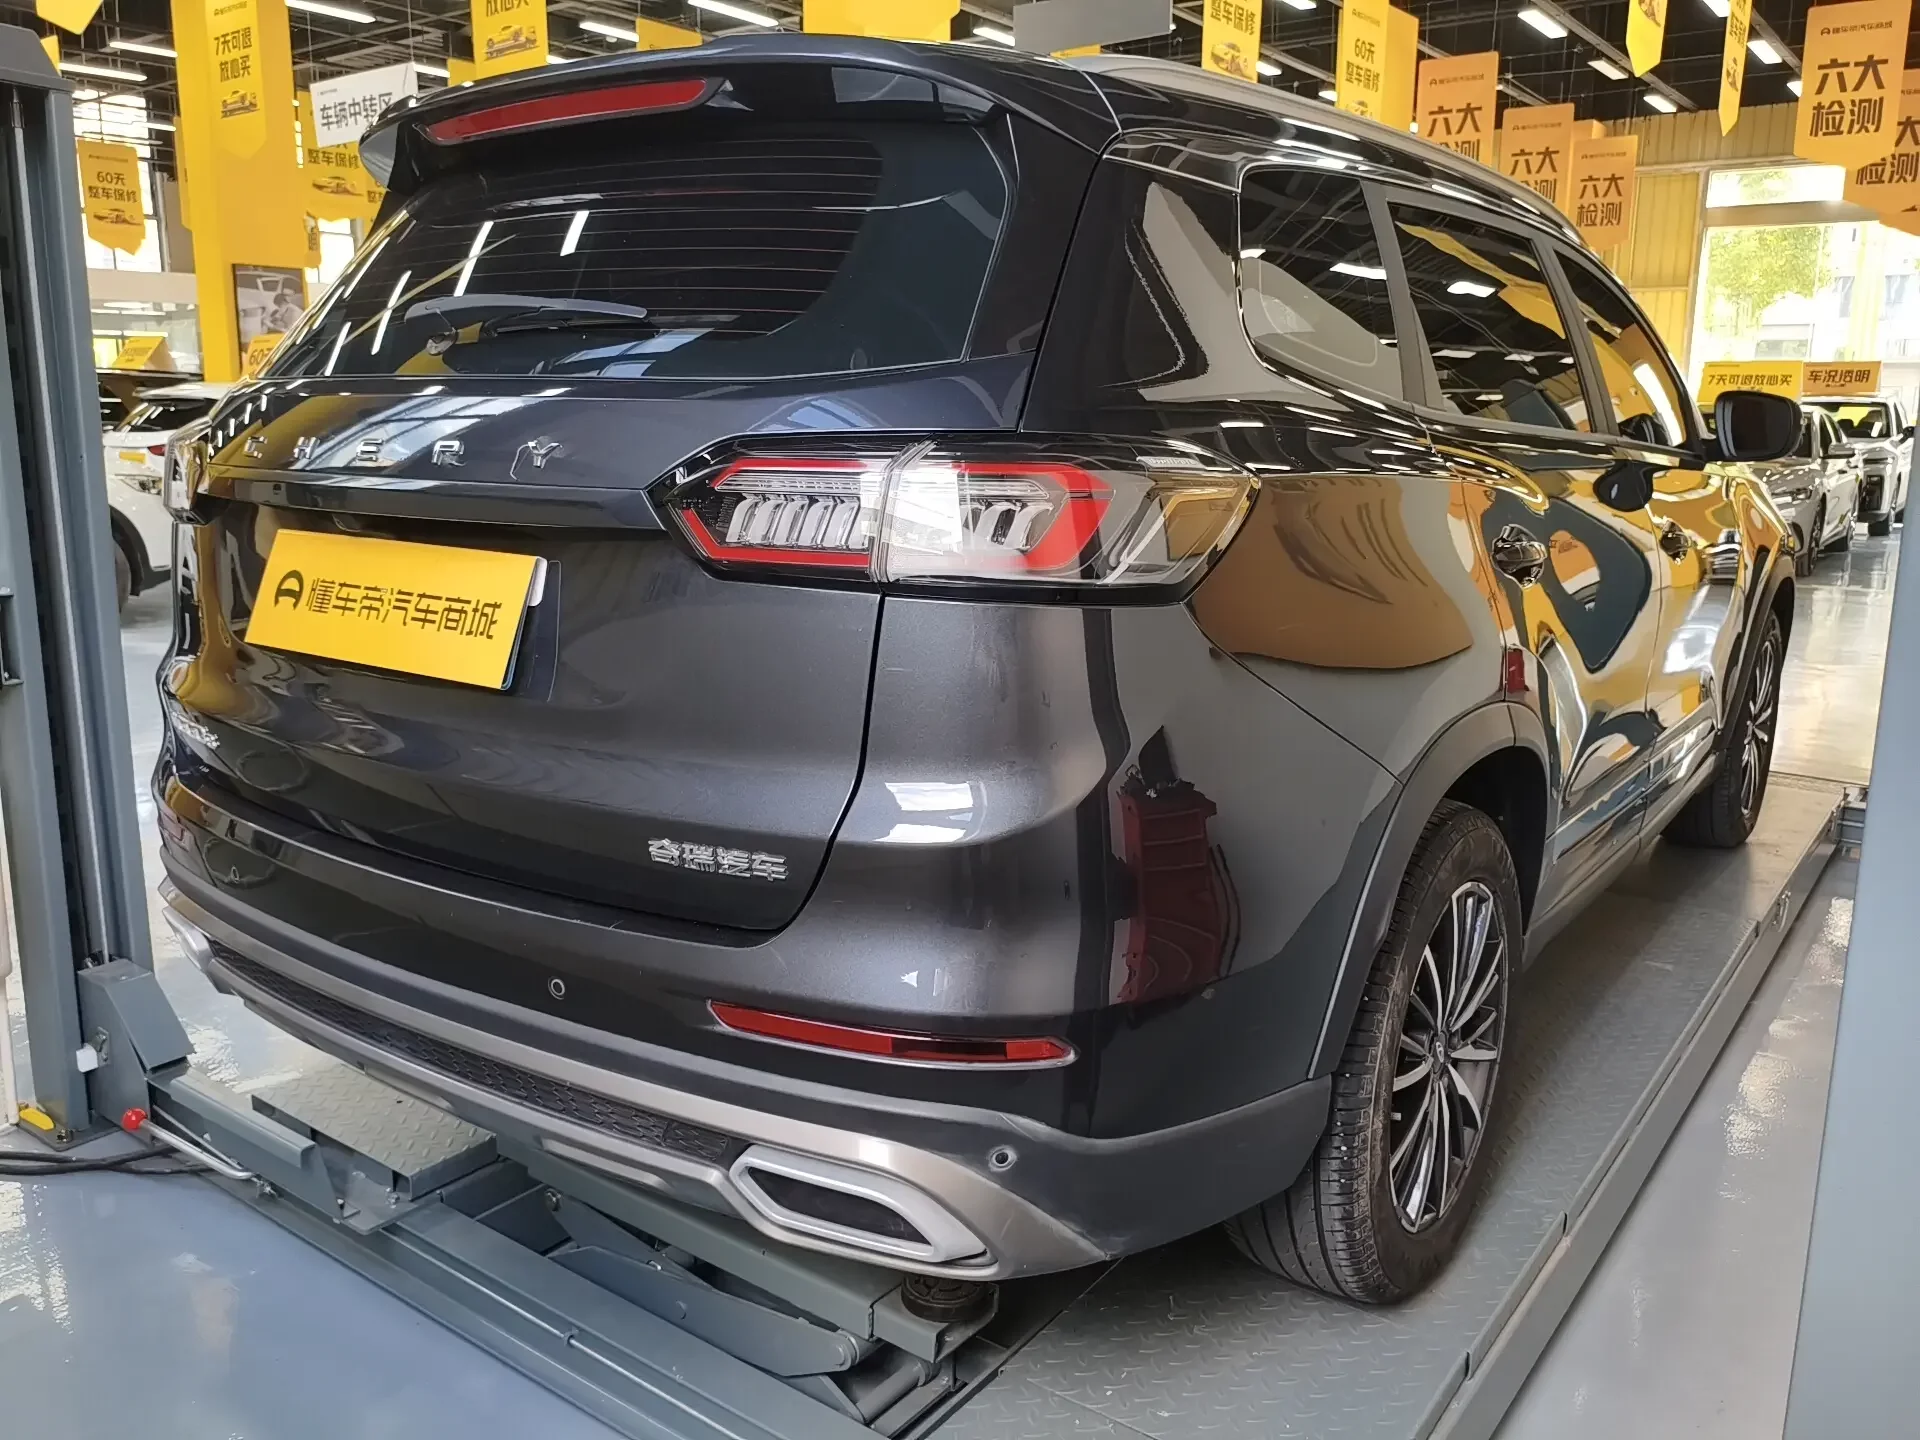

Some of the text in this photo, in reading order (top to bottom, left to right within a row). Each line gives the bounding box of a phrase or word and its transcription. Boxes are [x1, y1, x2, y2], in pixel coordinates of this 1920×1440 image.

[214, 27, 252, 55] 7天可退
[1354, 38, 1375, 64] 60天
[219, 55, 251, 82] 放心买
[1345, 61, 1380, 93] 整车保修
[1815, 54, 1889, 95] 六大
[320, 92, 393, 131] 车辆中转区
[1427, 102, 1483, 137] 六大
[1809, 96, 1884, 137] 检测
[307, 148, 360, 169] 整车保修
[1439, 138, 1480, 161] 测
[1510, 146, 1560, 176] 六大
[97, 171, 126, 186] 60天
[1856, 151, 1920, 185] 检测
[88, 186, 137, 203] 整车保修
[1522, 178, 1557, 203] 测
[1580, 173, 1625, 199] 六大
[1576, 202, 1622, 227] 检测
[1708, 374, 1793, 386] 7天可退放心买
[1807, 369, 1871, 384] 车况透明
[244, 436, 563, 481] CHERY
[305, 577, 503, 640] 懂车帝汽车商城
[648, 838, 788, 881] 奇瑞汽车
